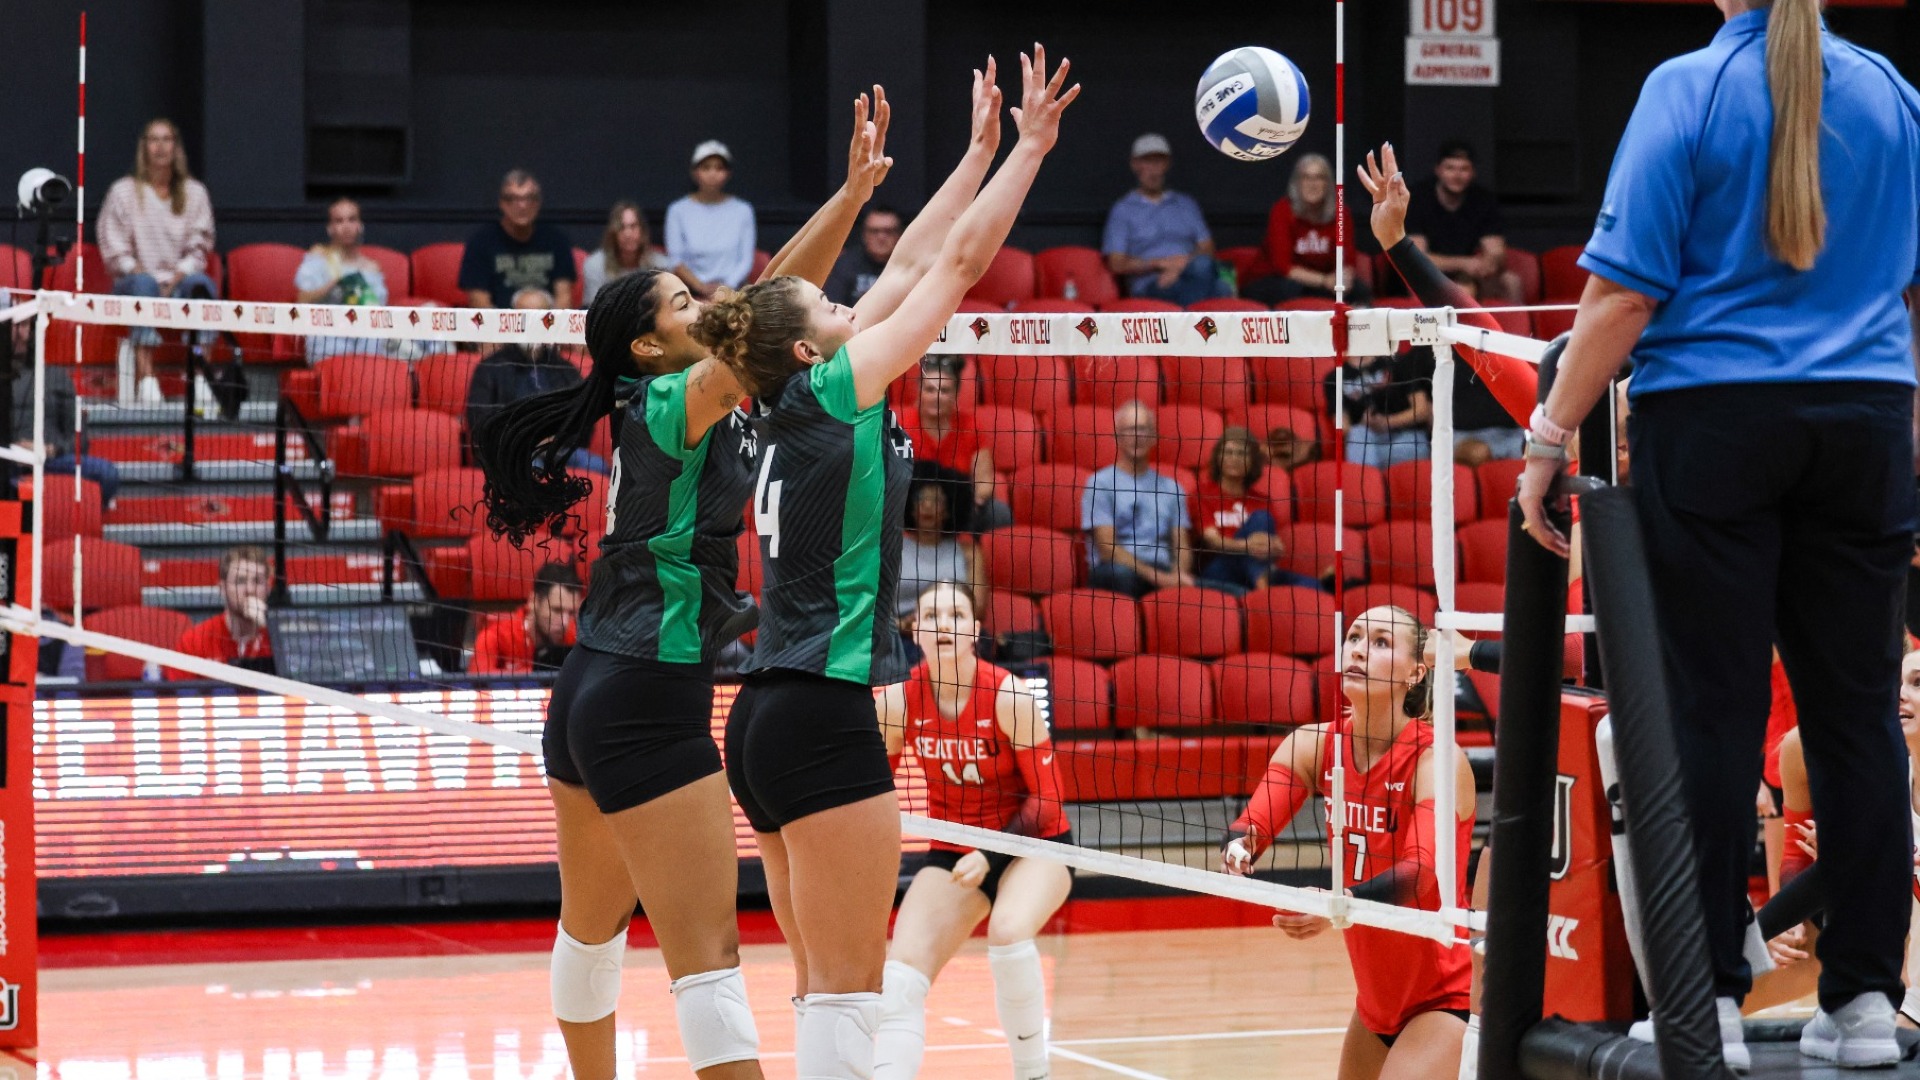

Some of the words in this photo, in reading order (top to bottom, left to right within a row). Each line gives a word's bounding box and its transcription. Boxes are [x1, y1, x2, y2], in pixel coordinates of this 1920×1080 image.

[1423, 0, 1484, 32] 109
[1413, 64, 1491, 78] ADMISSION
[1010, 320, 1050, 344] SEATTLEU
[1122, 318, 1169, 344] SEATTLEU
[1241, 317, 1289, 344] SEATTLEU
[754, 444, 783, 558] 4
[941, 762, 984, 785] 14
[1348, 832, 1367, 881] 7
